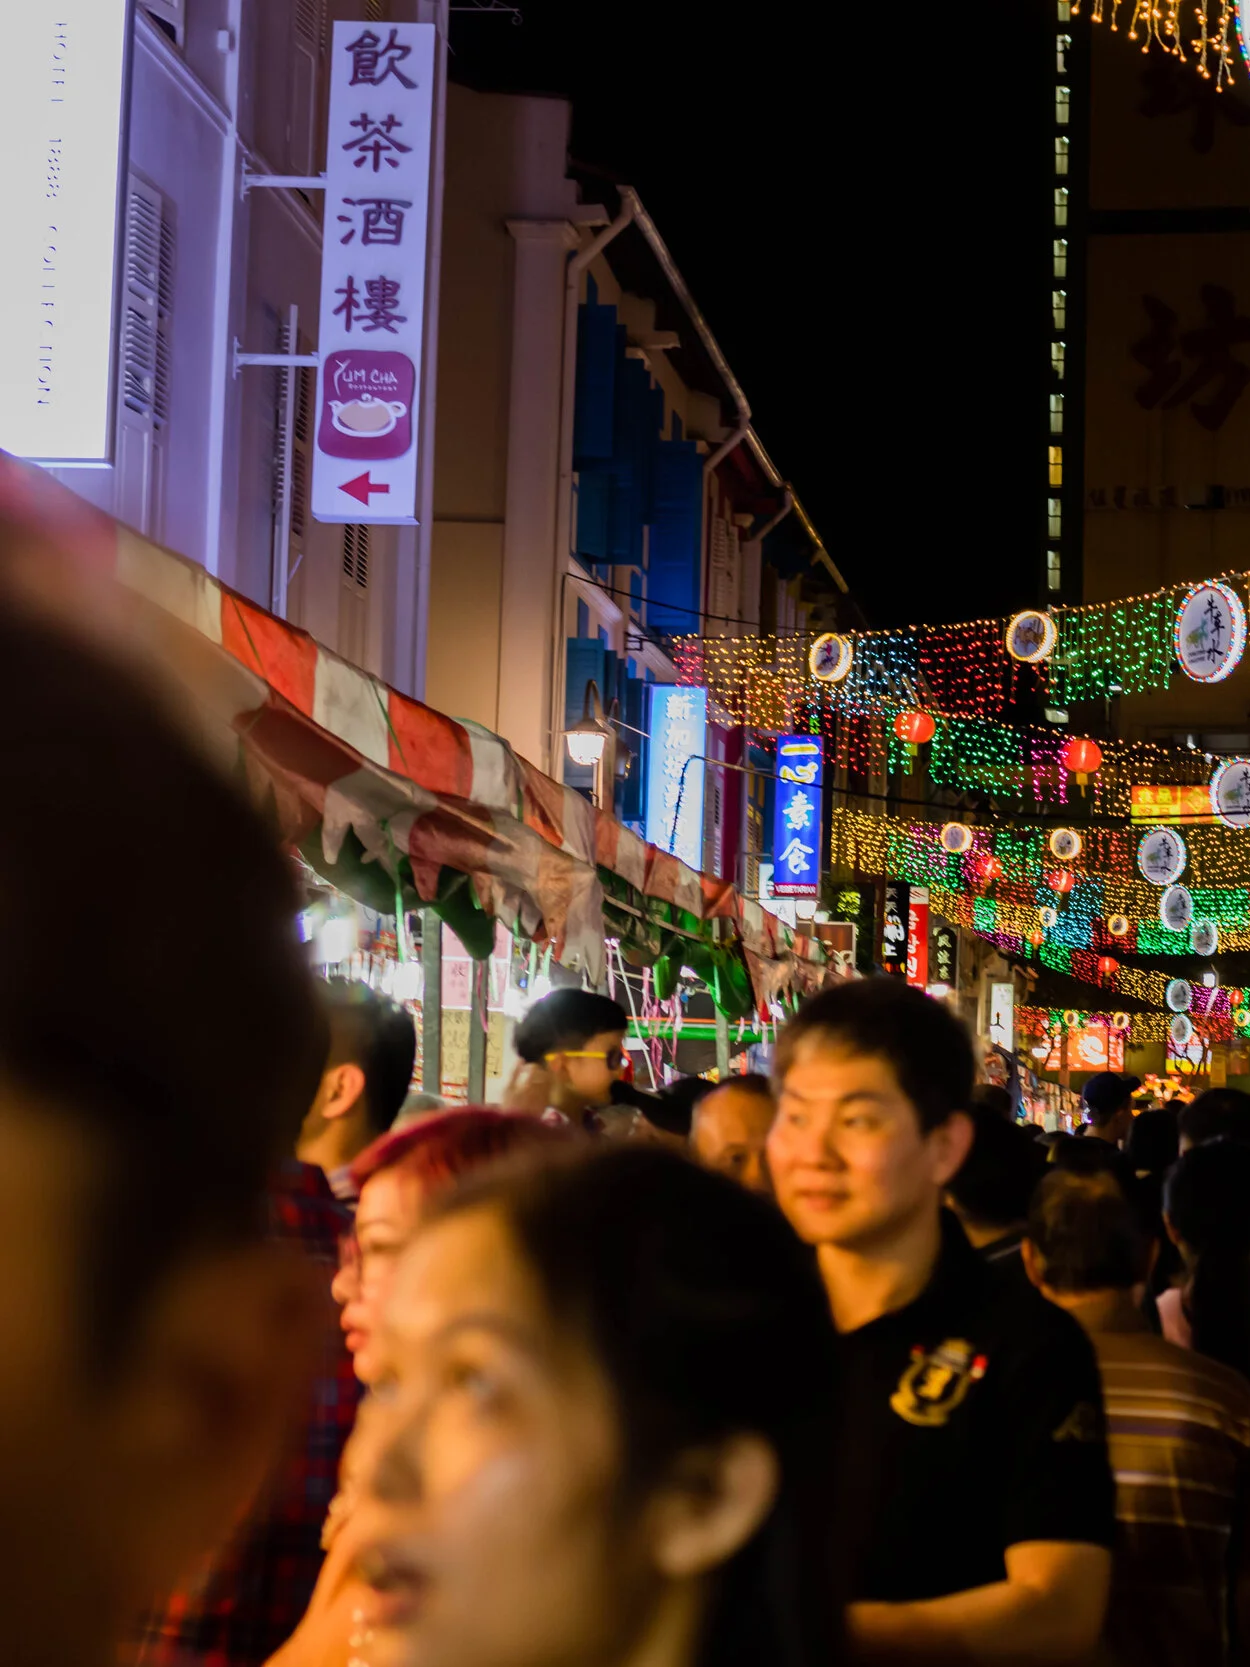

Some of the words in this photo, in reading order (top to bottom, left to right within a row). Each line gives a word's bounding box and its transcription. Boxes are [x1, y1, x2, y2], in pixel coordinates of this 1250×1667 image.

[332, 28, 419, 334] 飲茶酒樓
[779, 743, 820, 875] 一心素食
